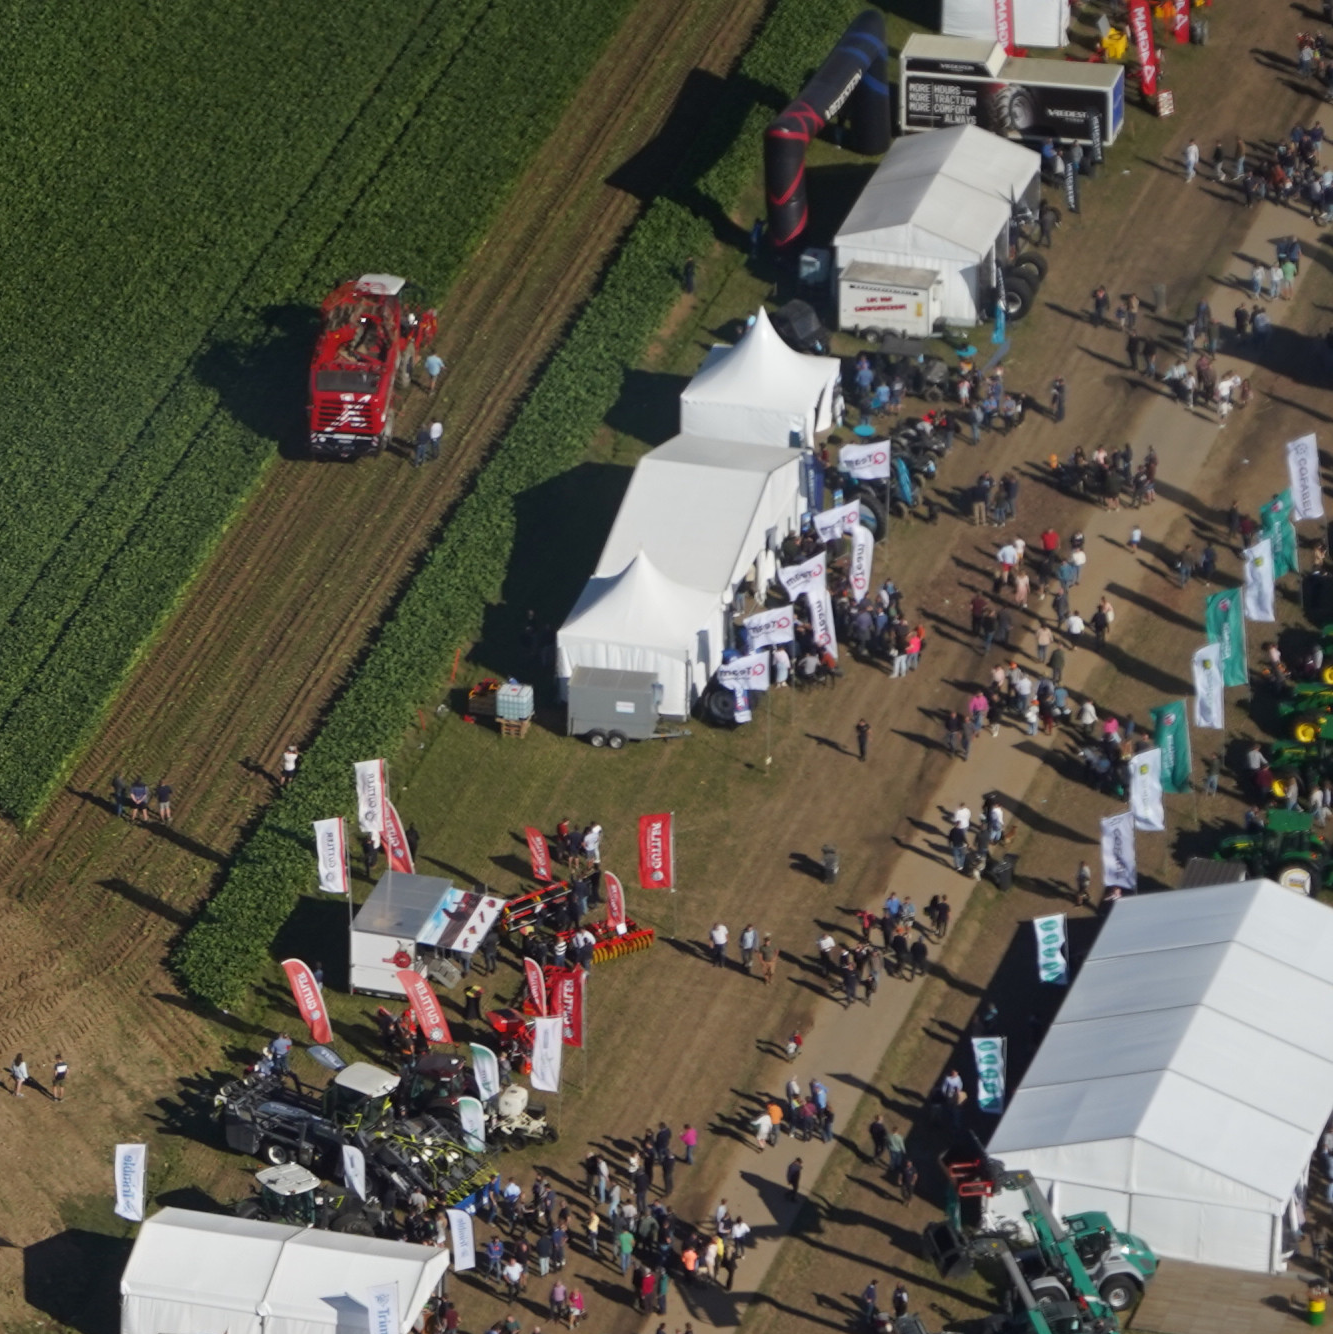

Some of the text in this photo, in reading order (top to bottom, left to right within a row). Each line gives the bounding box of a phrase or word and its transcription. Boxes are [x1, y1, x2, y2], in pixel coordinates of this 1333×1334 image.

[908, 83, 961, 95] MORE HOURS
[908, 93, 977, 107] MORE TRACTION
[908, 103, 971, 114] MORE COMFORT
